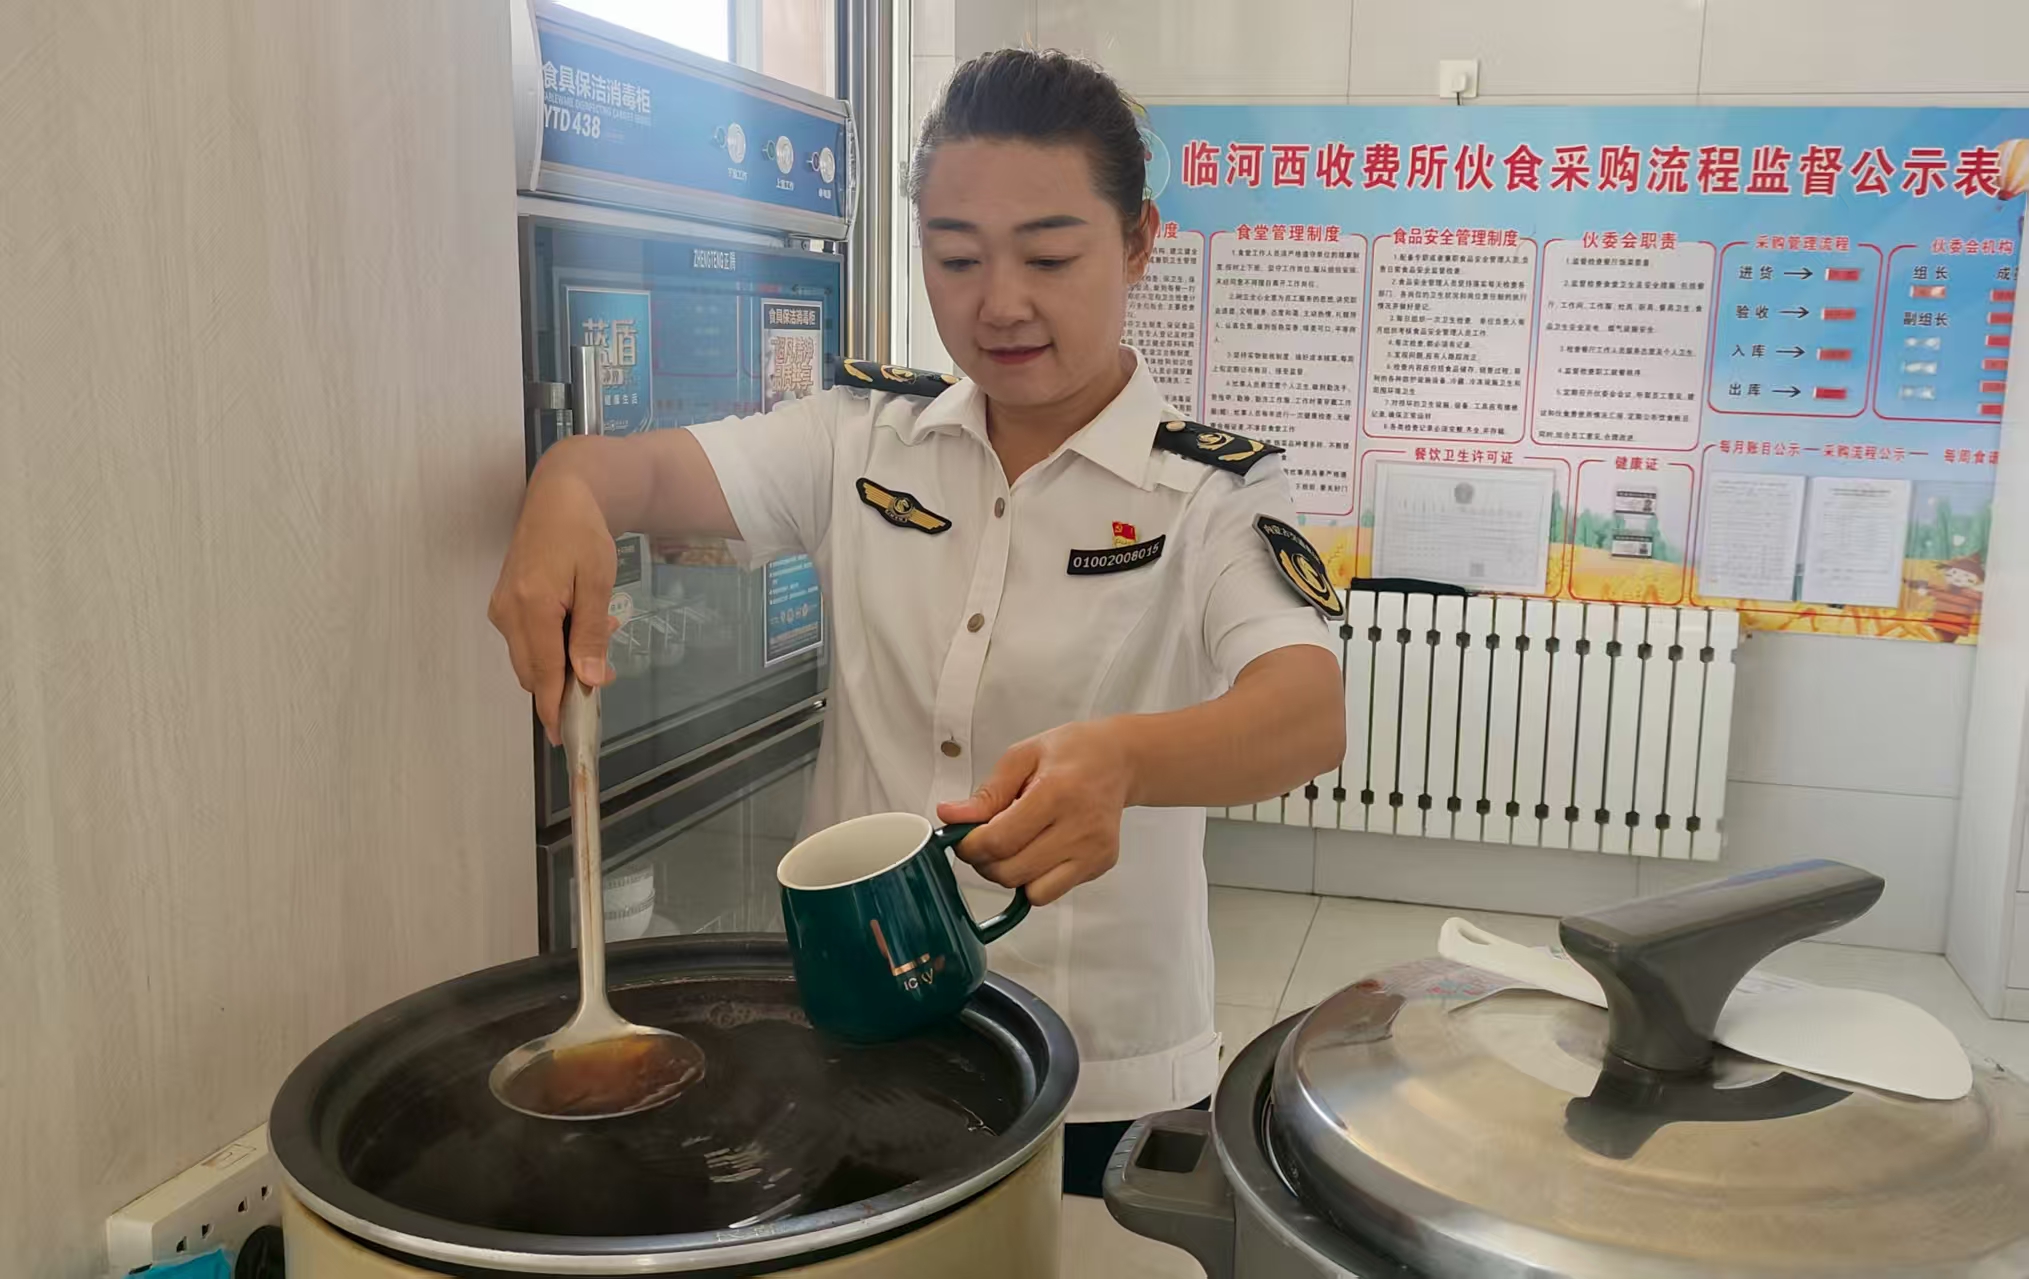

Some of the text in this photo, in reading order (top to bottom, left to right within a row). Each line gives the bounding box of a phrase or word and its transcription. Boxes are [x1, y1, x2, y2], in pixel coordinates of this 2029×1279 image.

[542, 61, 651, 114] 食具保洁消毒柜
[544, 104, 601, 138] YTD438
[1182, 139, 2001, 199] 临河西收费所伙食采购流程监督公示表
[1156, 222, 1178, 239] 度
[1237, 224, 1340, 242] 食堂管理制度
[1393, 227, 1519, 247] 食品安全管理制度
[1582, 231, 1678, 250] 伙委会职责
[1756, 235, 1849, 251] 采购管理流程
[1931, 238, 2015, 255] 伙委会机构
[1739, 264, 1773, 280] 进货
[1913, 265, 1949, 280] 组长
[1736, 305, 1769, 319] 验收
[1903, 311, 1950, 326] 副组长
[1732, 344, 1765, 357] 入库
[1728, 383, 1761, 396] 出库
[1415, 447, 1514, 465] 餐饮卫生许可证
[1719, 439, 1800, 458] 每月账目公示
[1823, 443, 1905, 462] 采购流程公示
[1615, 456, 1659, 472] 健康证
[1073, 541, 1160, 568] 01002008015
